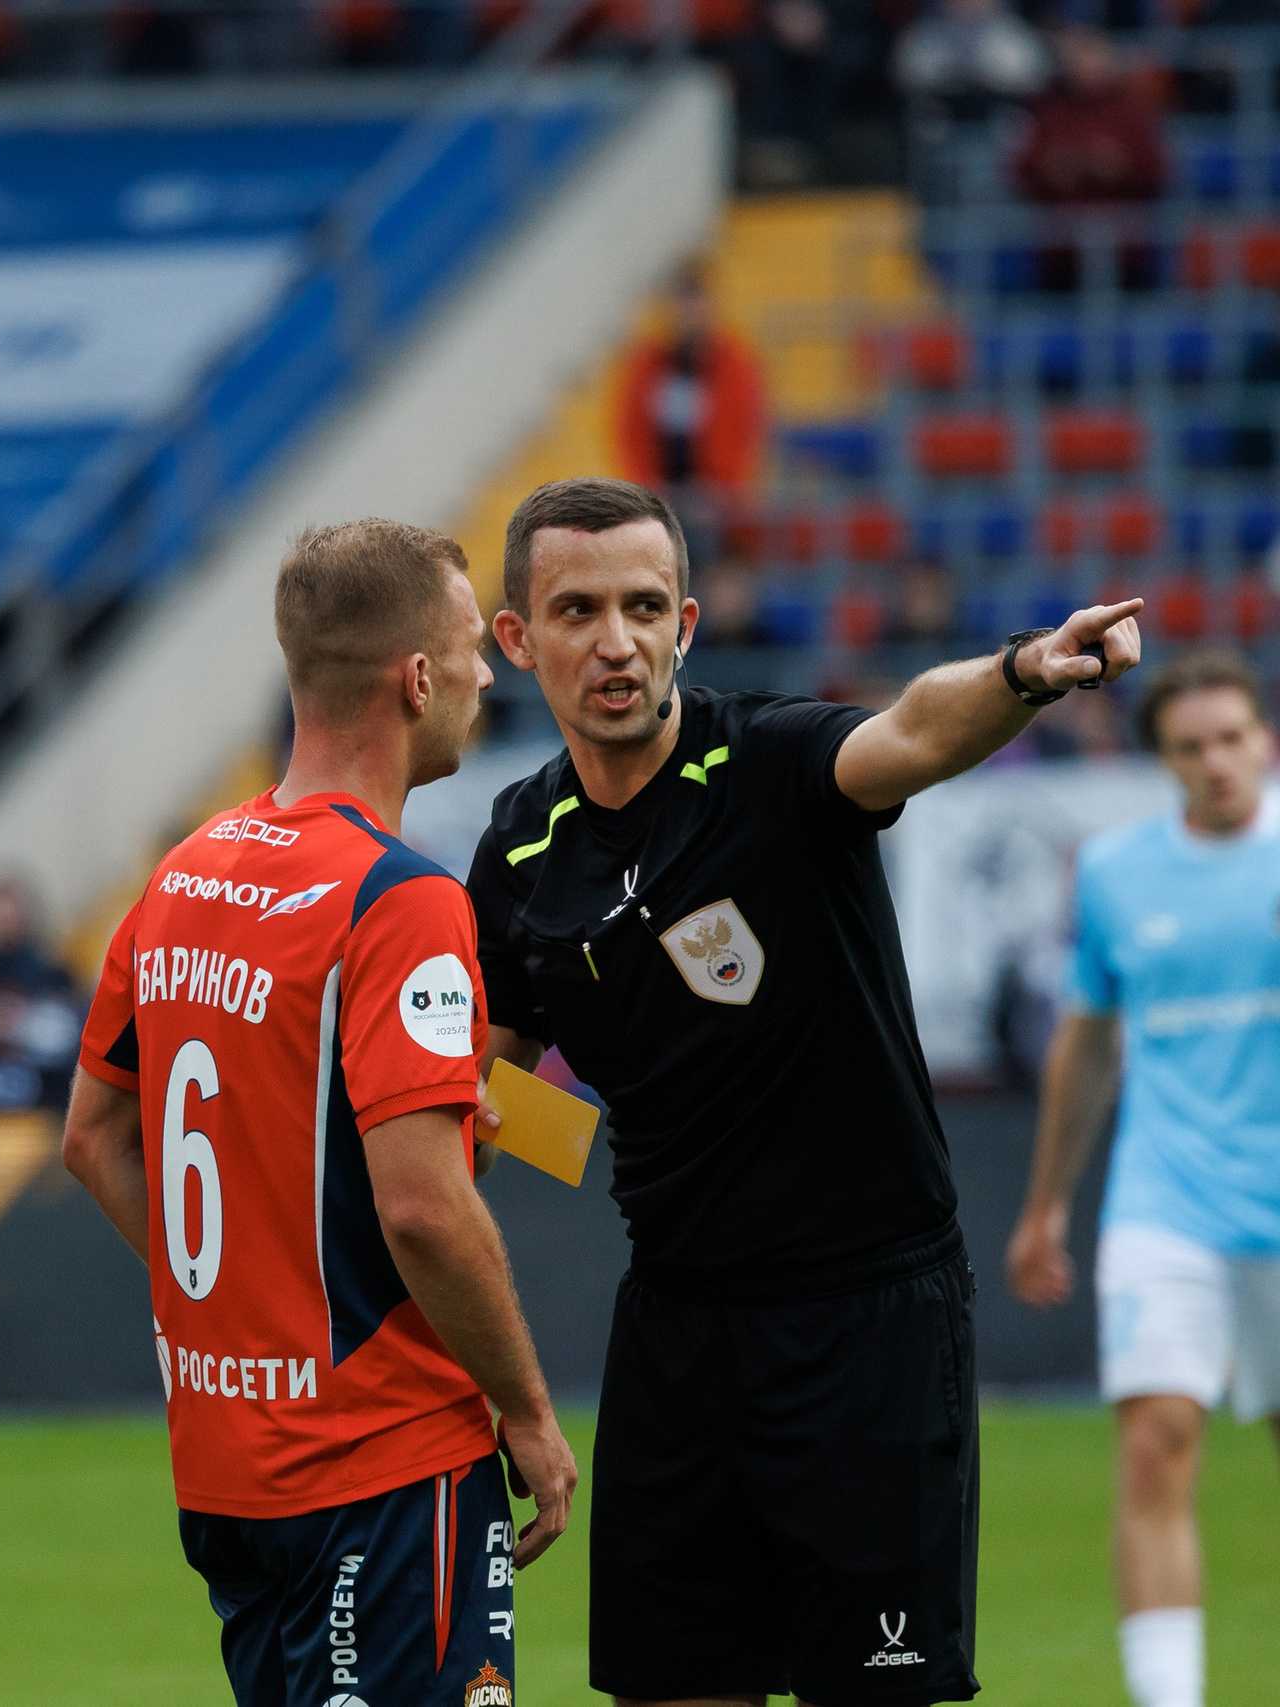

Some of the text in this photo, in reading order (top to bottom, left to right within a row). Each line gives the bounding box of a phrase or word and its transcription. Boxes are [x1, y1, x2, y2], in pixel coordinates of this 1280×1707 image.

[158, 871, 278, 910] АЭРОФЛОТ
[139, 947, 273, 1024] БАРИНОВ
[413, 1011, 450, 1021] РОССИЙСКАЯ
[161, 1037, 223, 1302] 6
[178, 1346, 317, 1401] РОССЕТИ
[329, 1554, 366, 1685] РОССЕТИ
[863, 1651, 926, 1667] JÖGEL
[470, 1685, 509, 1707] ЦСКА
